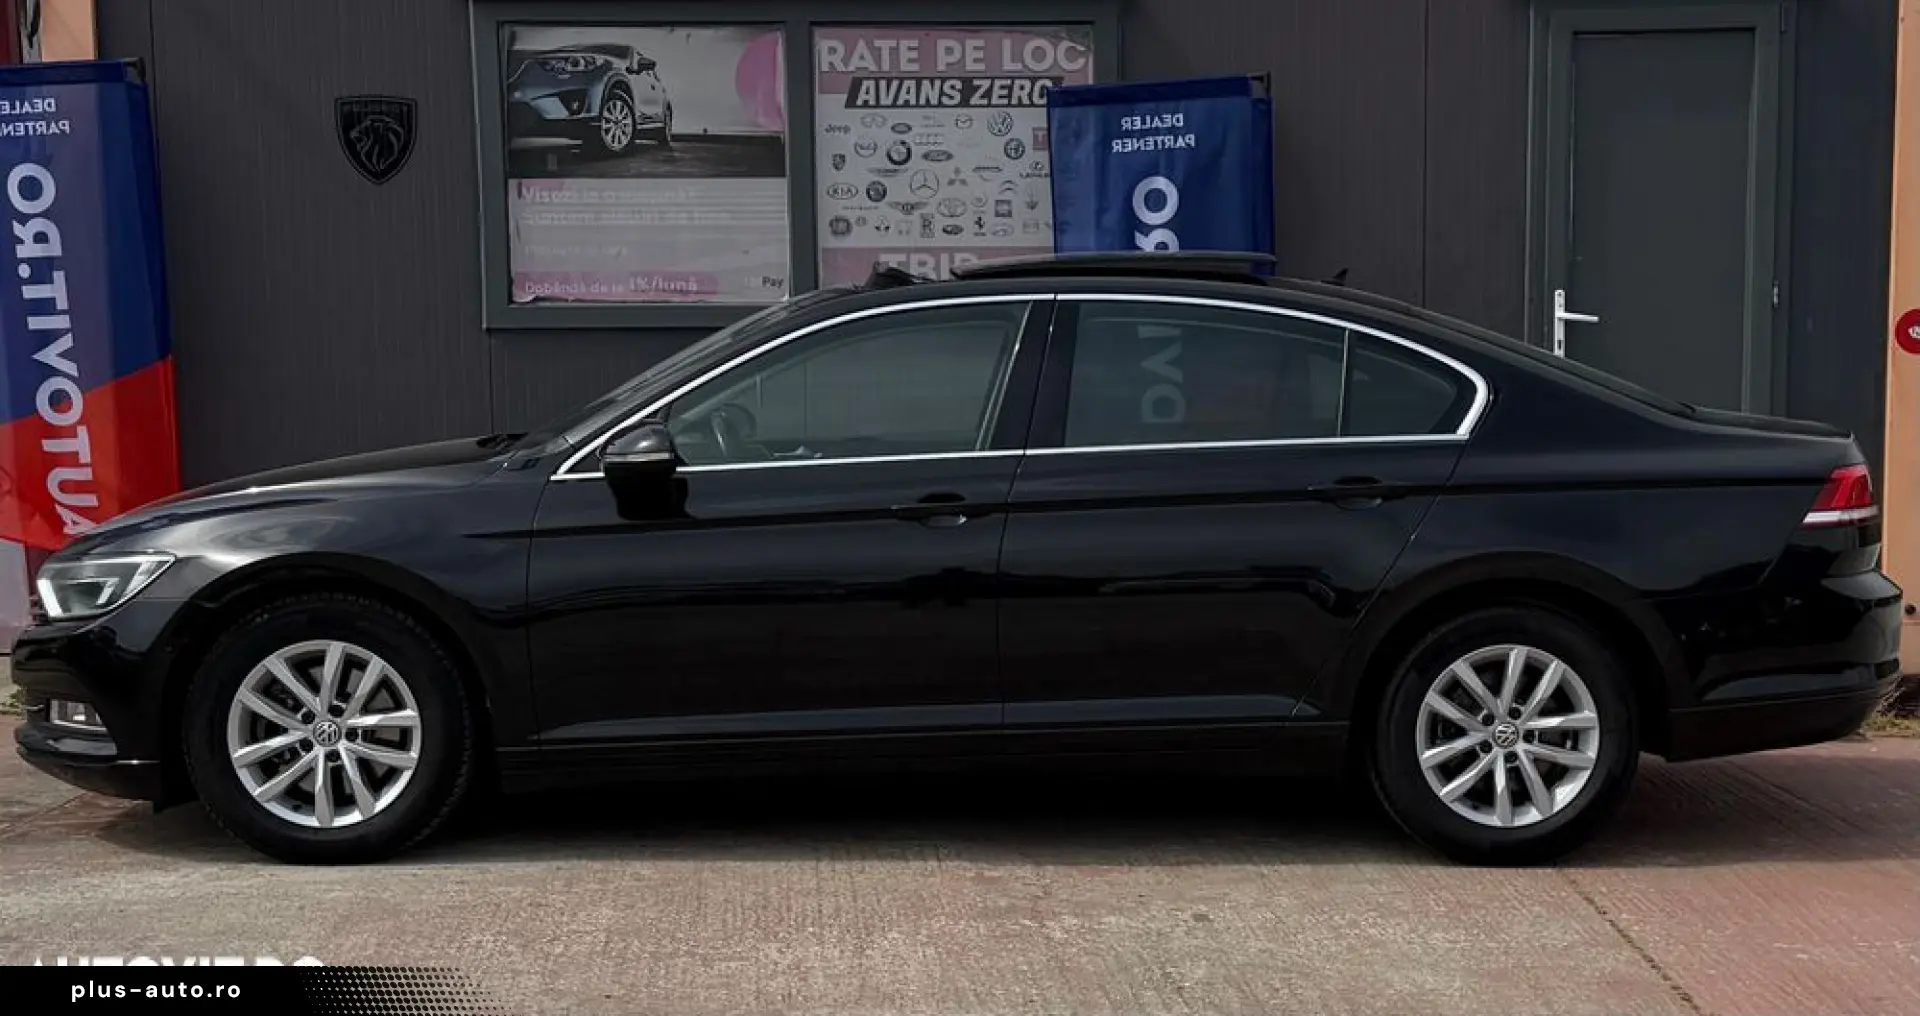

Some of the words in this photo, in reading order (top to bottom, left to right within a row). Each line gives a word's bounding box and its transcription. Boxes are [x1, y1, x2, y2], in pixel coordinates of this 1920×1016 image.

[819, 38, 919, 72] RATE
[936, 38, 986, 72] PE
[1001, 38, 1087, 72] LOC
[856, 78, 963, 106] AVANS
[761, 275, 784, 289] Pay
